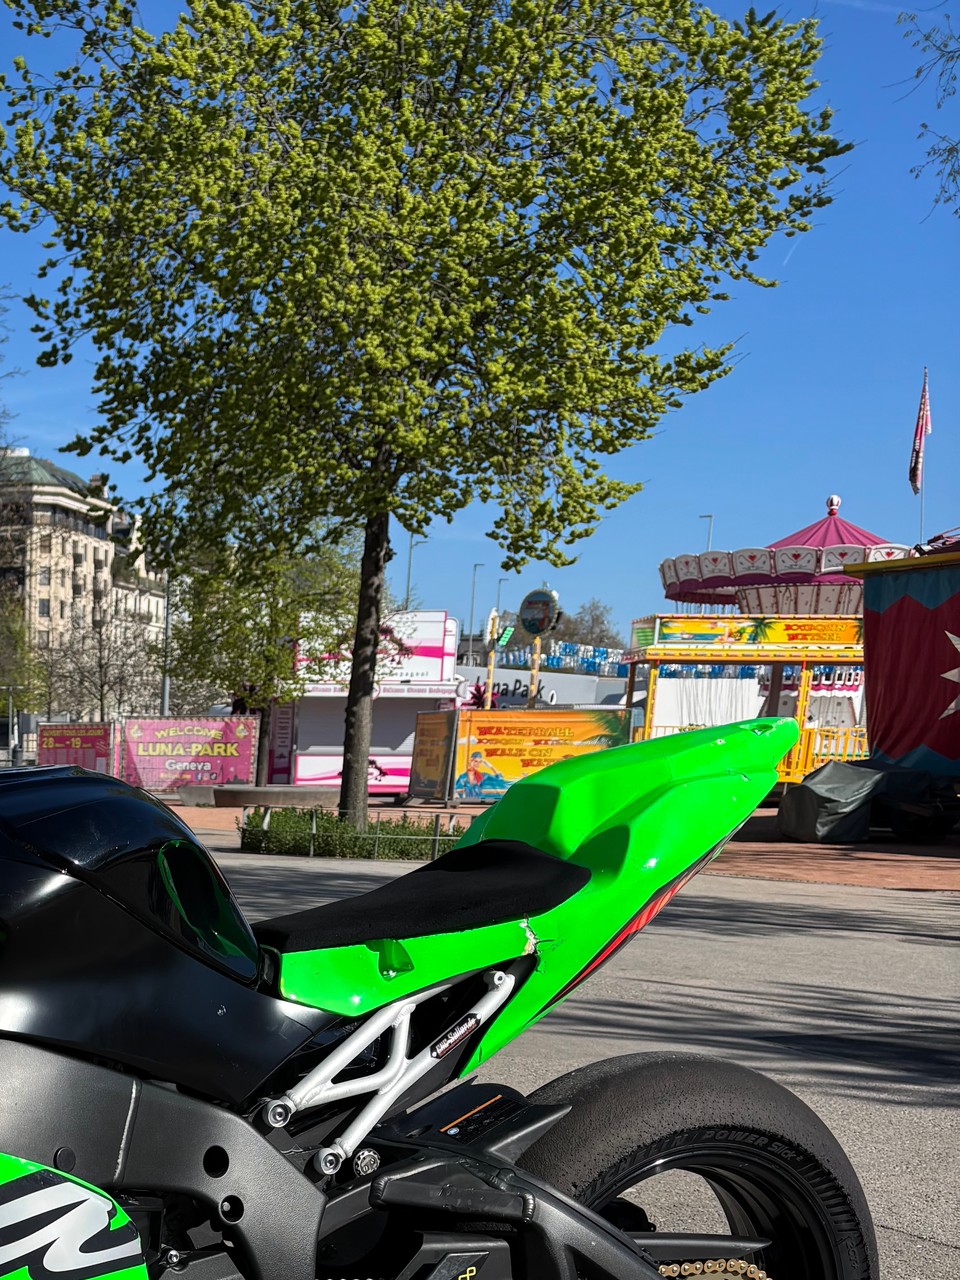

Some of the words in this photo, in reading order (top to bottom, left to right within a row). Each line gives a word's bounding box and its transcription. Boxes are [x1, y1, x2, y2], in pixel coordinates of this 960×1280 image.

[512, 678, 545, 699] Pak
[155, 726, 224, 740] WELCOME
[42, 737, 55, 748] 28
[137, 742, 239, 756] LUNA-PARK
[528, 747, 553, 758] ON
[165, 759, 211, 771] Geneva
